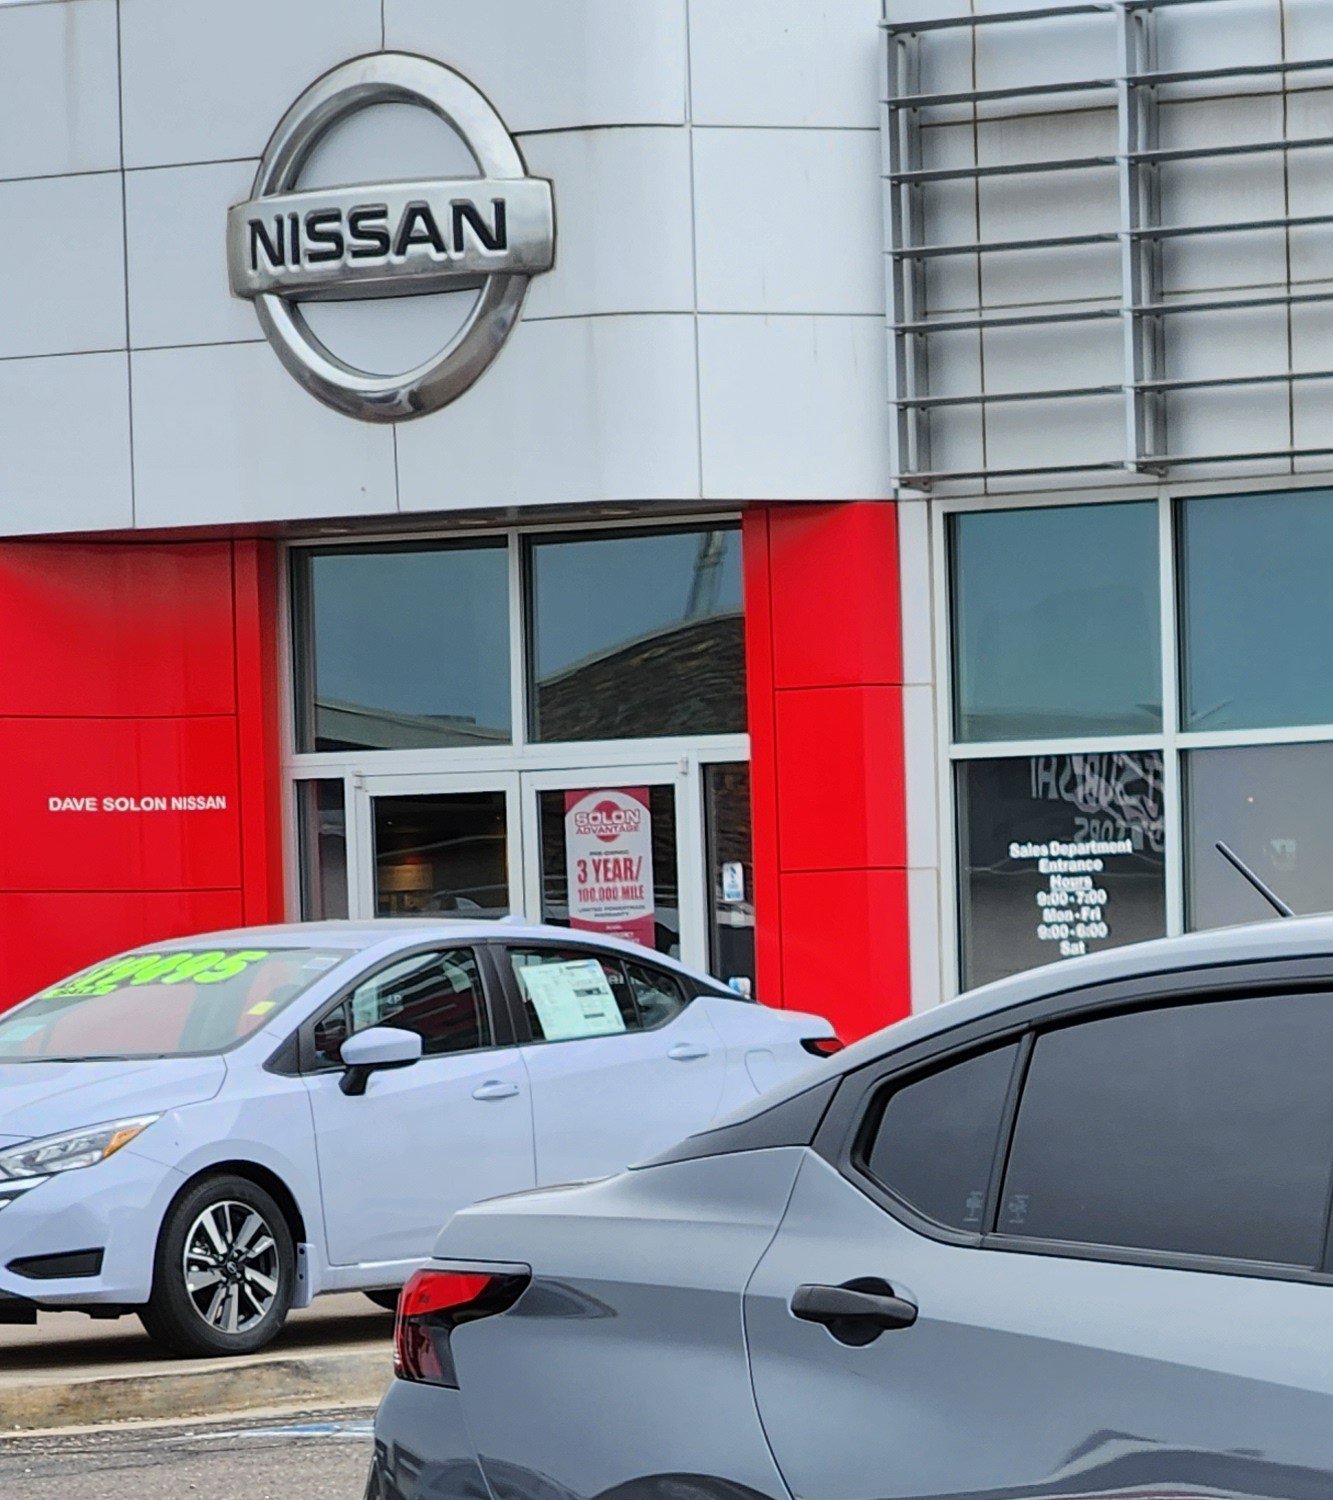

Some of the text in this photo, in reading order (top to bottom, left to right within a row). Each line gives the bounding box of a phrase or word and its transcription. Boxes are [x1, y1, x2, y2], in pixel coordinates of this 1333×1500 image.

[249, 198, 507, 271] NISSAN
[48, 796, 227, 812] DAVE SOLON NISSAN
[575, 809, 640, 827] SOLON
[576, 824, 640, 835] ADVANTAGE
[1009, 839, 1133, 858] Sales Department
[577, 856, 643, 884] 3 YEAR/
[1038, 858, 1103, 874] Entrance
[1050, 874, 1093, 889] Hours
[621, 885, 645, 901] MILE
[1060, 940, 1086, 956] Sat
